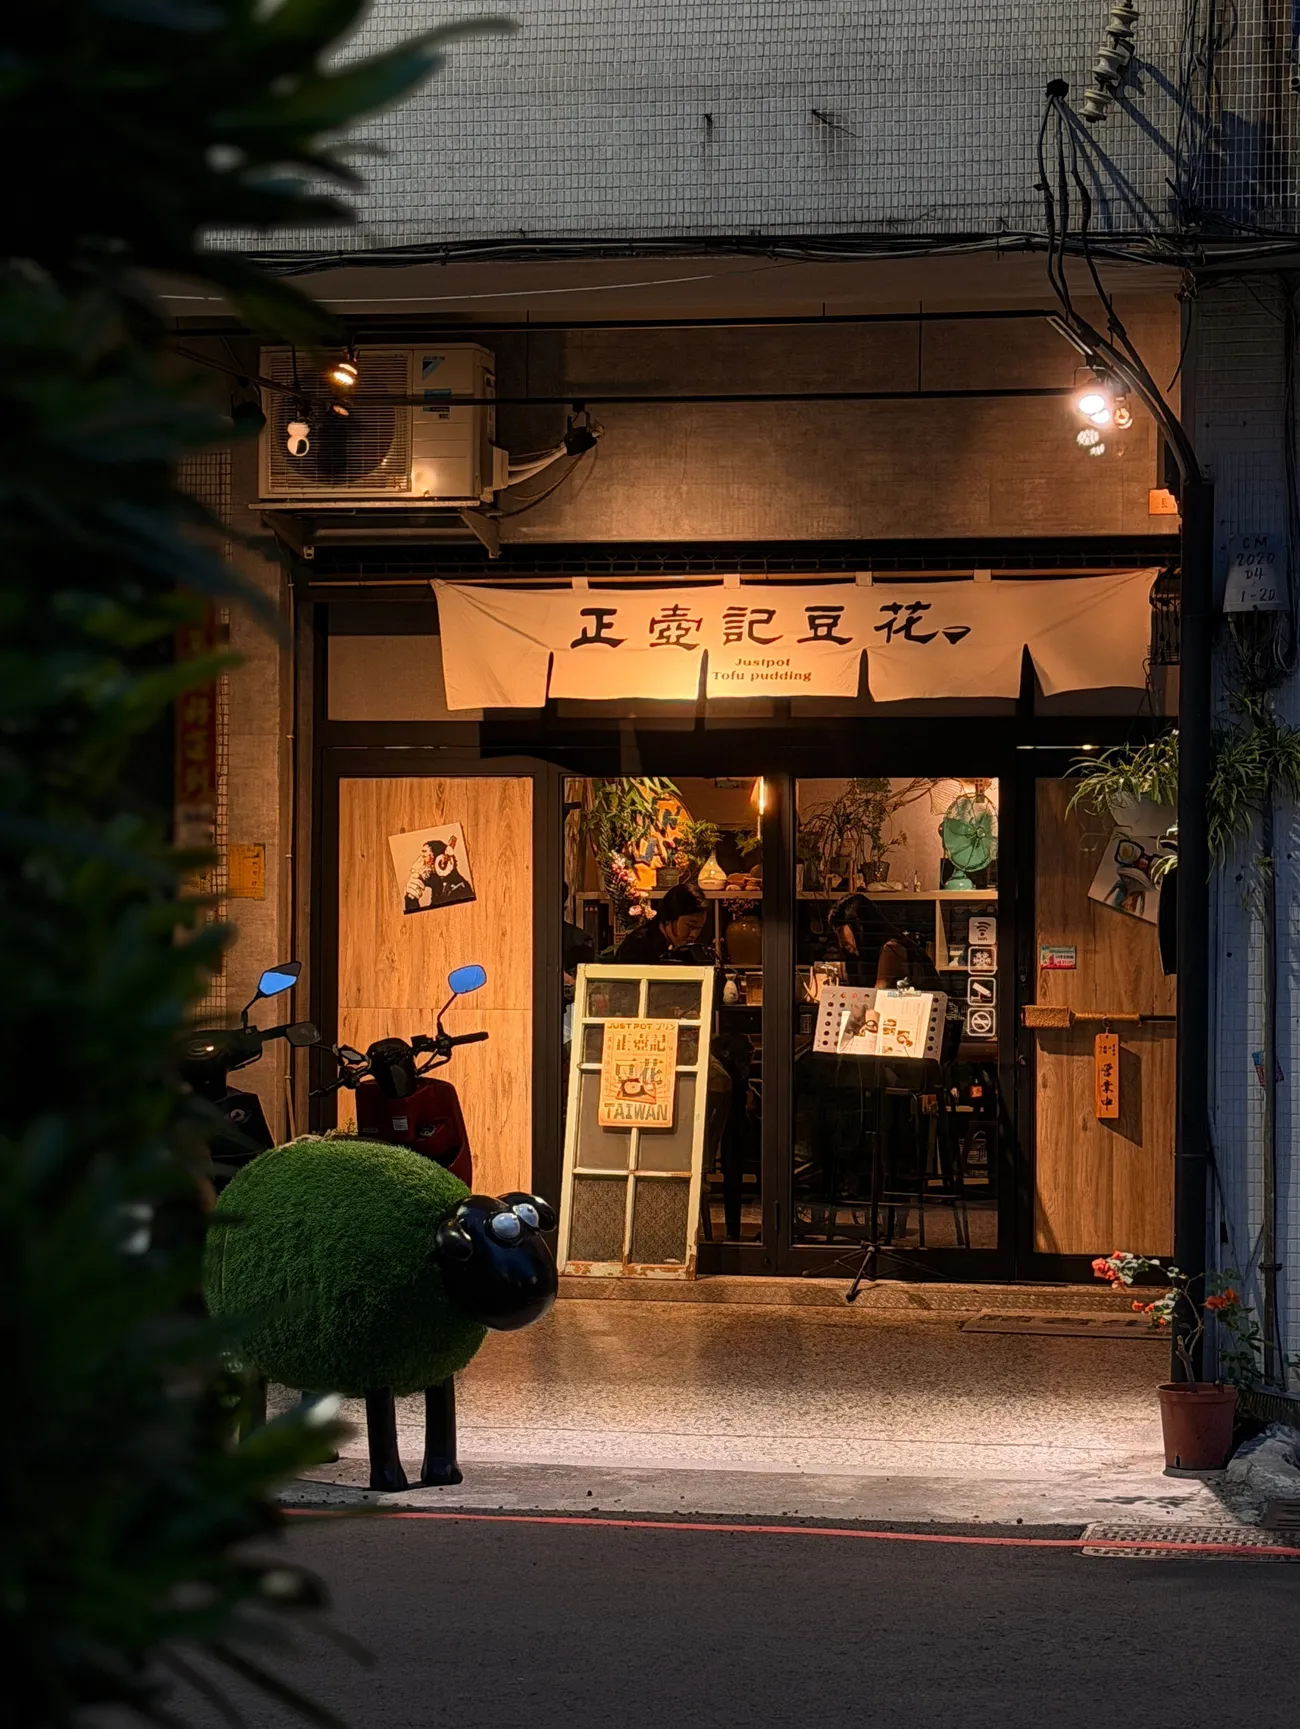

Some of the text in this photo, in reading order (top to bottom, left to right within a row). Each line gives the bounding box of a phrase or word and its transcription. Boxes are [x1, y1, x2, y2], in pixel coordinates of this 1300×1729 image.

[1237, 552, 1275, 566] 2020
[735, 657, 791, 668] Justpot
[712, 670, 812, 683] Tofu pudding
[603, 1102, 668, 1121] TAIWAN
